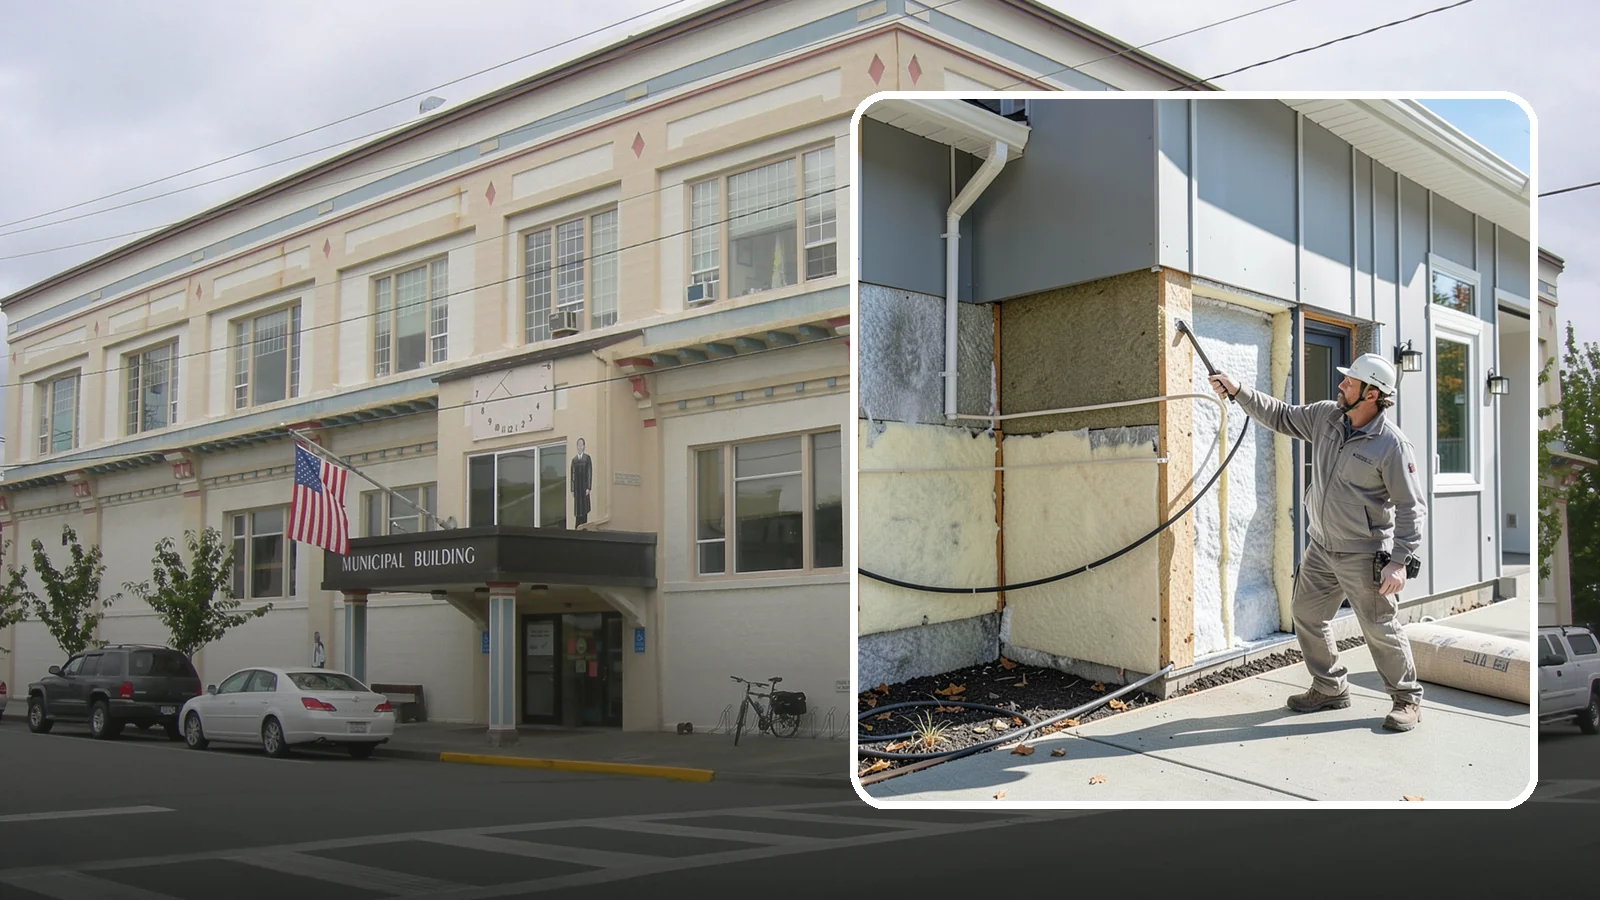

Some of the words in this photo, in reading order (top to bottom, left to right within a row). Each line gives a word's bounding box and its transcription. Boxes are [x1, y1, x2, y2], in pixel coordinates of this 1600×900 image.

[475, 390, 479, 398] 7
[536, 402, 540, 410] 4
[481, 407, 485, 415] 8
[488, 417, 492, 426] 9
[529, 414, 533, 422] 3
[521, 420, 525, 428] 2
[502, 425, 506, 433] 11
[508, 425, 513, 433] 12
[342, 552, 405, 572] MUNICIPAL
[414, 546, 475, 567] BUILDING
